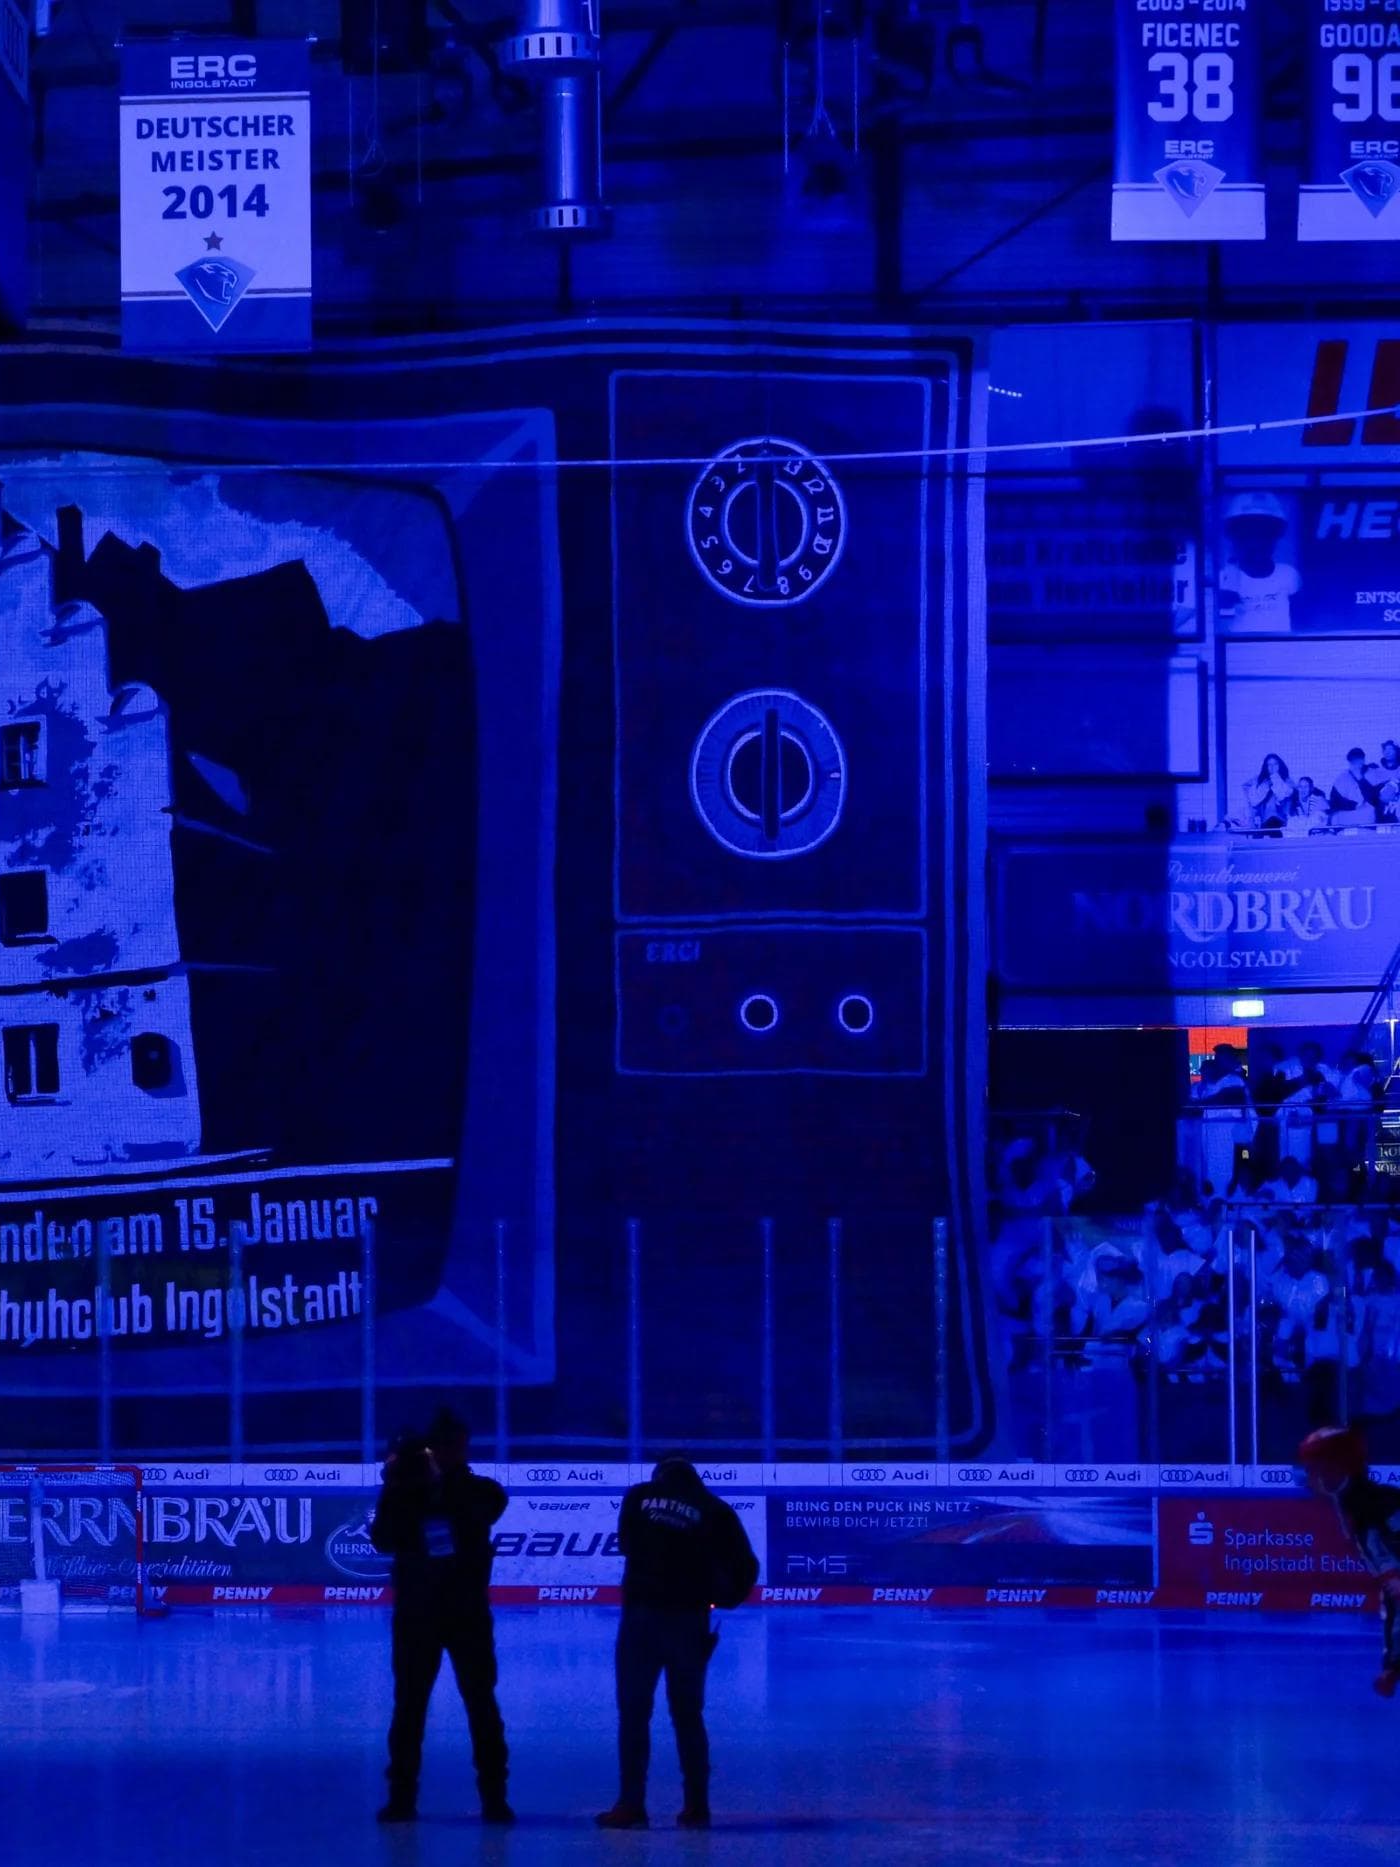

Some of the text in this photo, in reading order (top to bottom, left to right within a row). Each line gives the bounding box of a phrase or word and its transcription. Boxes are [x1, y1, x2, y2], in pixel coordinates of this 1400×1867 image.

[1141, 22, 1241, 47] FICENEC
[169, 54, 257, 79] ERC
[169, 78, 257, 88] INGOLSTADT
[1146, 51, 1235, 122] 38
[135, 114, 296, 140] DEUTSCHER
[1164, 140, 1215, 154] ERC
[1350, 141, 1400, 154] ERC
[150, 148, 281, 172] MEISTER
[161, 183, 270, 220] 2014
[699, 504, 713, 519] 4
[701, 535, 719, 550] 5
[1356, 591, 1400, 606] ENTS
[105, 1212, 163, 1256] am
[173, 1197, 227, 1252] 15.
[238, 1191, 377, 1247] Januar
[165, 1270, 365, 1339] Ingolstadt
[173, 1468, 210, 1482] Audi
[304, 1468, 341, 1482] Audi
[566, 1469, 604, 1482] Audi
[701, 1470, 738, 1483] Audi
[892, 1468, 930, 1482] Audi
[998, 1468, 1036, 1482] Audi
[1103, 1469, 1141, 1483] Audi
[1193, 1469, 1230, 1483] Audi
[785, 1501, 830, 1513] BRING
[833, 1501, 862, 1513] DEN
[866, 1501, 904, 1513] PUCK
[908, 1501, 931, 1513] INS
[935, 1501, 971, 1513] NETZ
[785, 1516, 929, 1529] BEWIRB DICH JETZT!
[1223, 1530, 1314, 1551] Sparkasse
[786, 1555, 848, 1575] FMS
[1224, 1554, 1312, 1576] Ingolstadt
[212, 1585, 274, 1601] PENNY
[323, 1585, 385, 1601] PENNY
[537, 1586, 598, 1601] PENNY
[760, 1587, 823, 1602] PENNY
[872, 1587, 934, 1602] PENNY
[985, 1588, 1047, 1603] PENNY
[1095, 1589, 1155, 1605] PENNY
[1205, 1591, 1264, 1606] PENNY
[1309, 1592, 1367, 1608] PENNY
